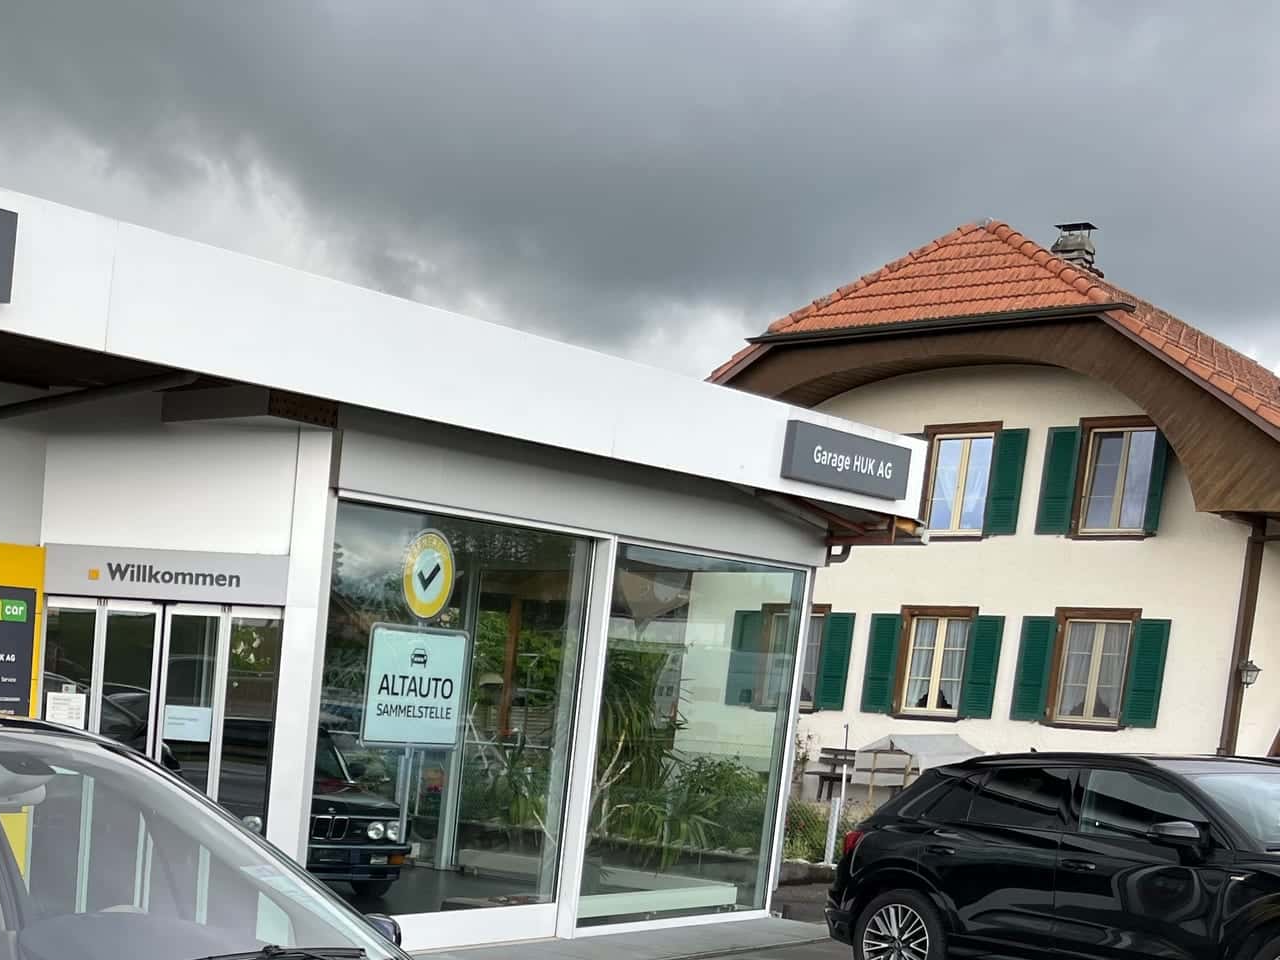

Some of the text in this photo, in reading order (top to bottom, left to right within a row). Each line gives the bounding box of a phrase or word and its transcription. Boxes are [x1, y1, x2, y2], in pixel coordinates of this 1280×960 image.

[813, 446, 892, 479] Garage HUK AG
[107, 563, 241, 588] Willkommen
[4, 604, 24, 616] car
[6, 654, 16, 662] AG
[378, 674, 454, 699] ALTAUTO
[376, 703, 452, 720] SAMMELSTELLE
